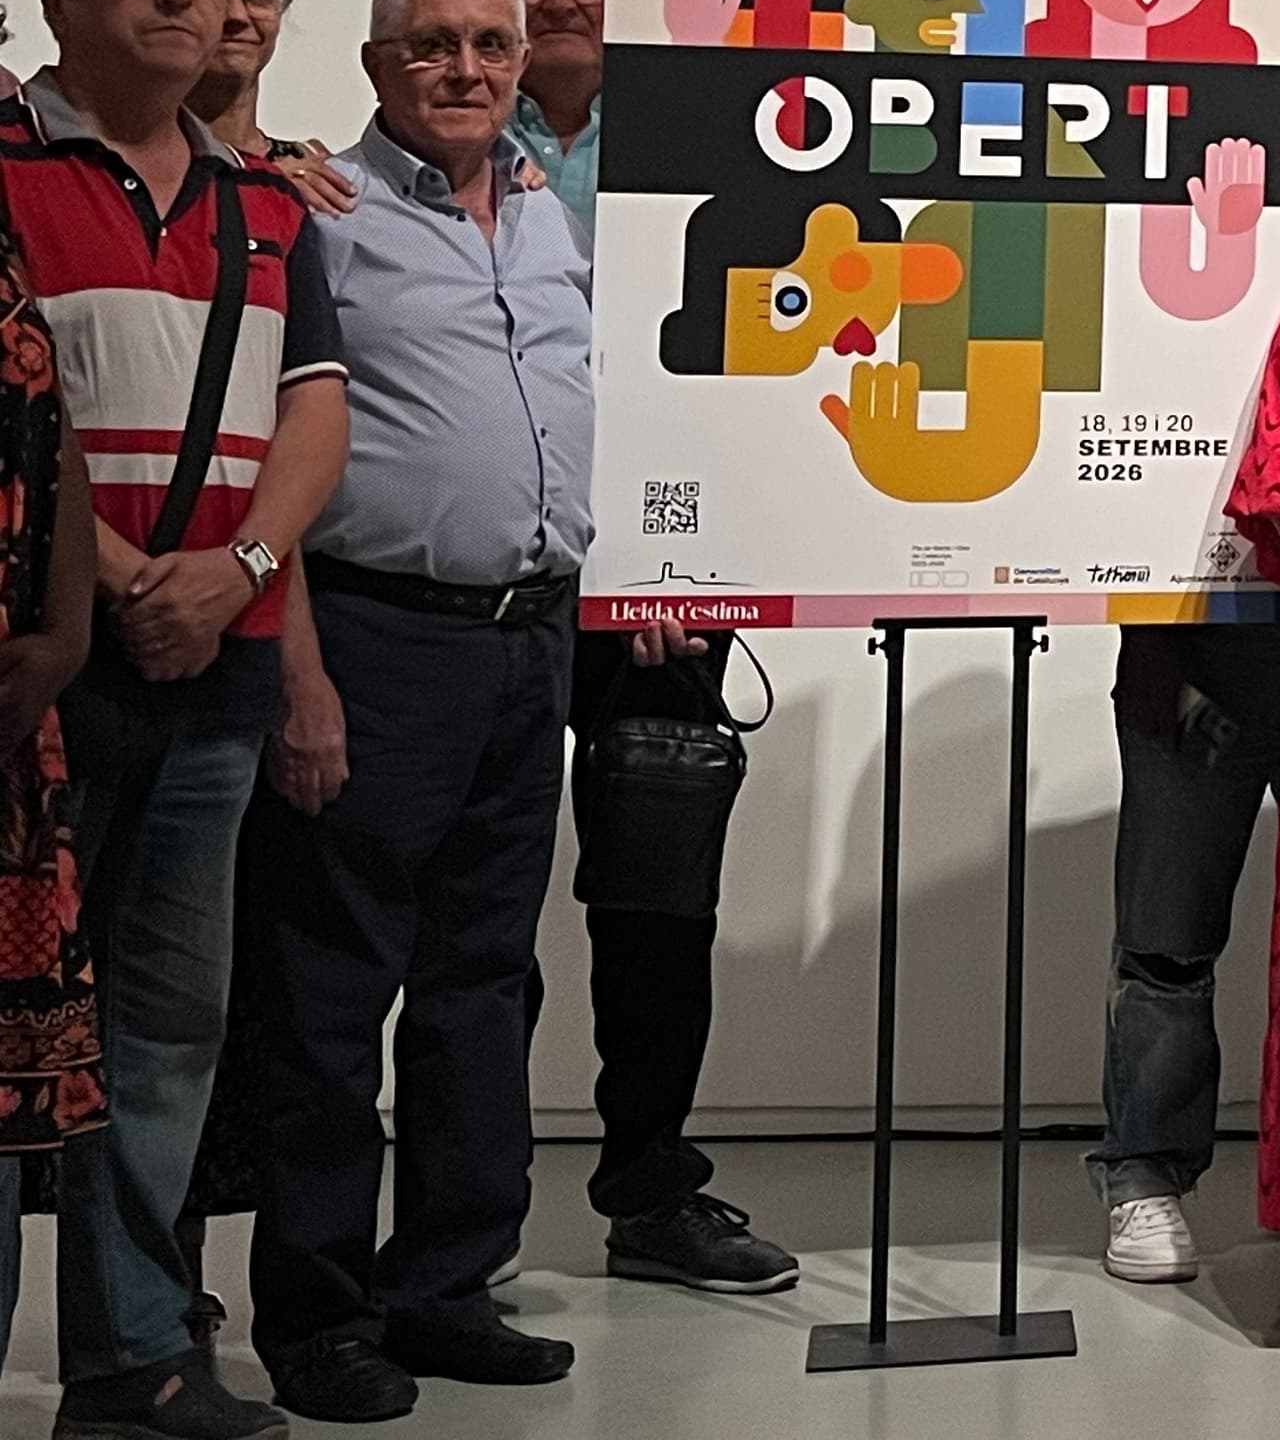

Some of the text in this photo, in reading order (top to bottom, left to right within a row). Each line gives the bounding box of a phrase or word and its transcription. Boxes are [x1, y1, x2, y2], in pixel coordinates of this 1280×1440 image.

[754, 75, 1190, 180] OBERT
[1080, 413, 1193, 435] 18, 19 i 20
[1078, 439, 1229, 457] SETEMBRE
[1077, 463, 1143, 482] 2026
[610, 601, 674, 621] Lleida
